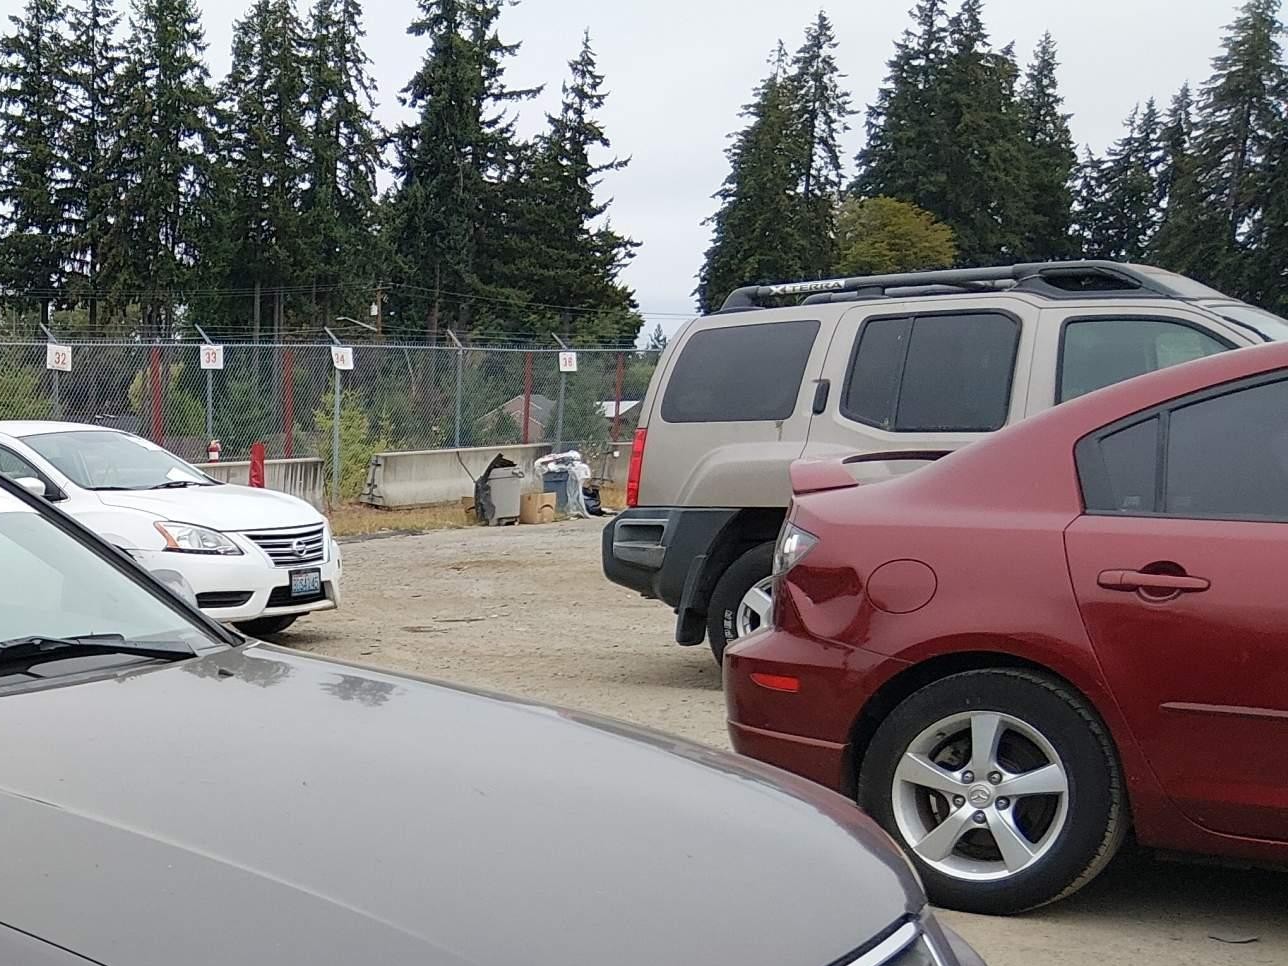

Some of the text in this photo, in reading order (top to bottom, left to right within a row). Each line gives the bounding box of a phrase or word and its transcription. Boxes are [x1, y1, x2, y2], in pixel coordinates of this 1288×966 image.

[769, 281, 842, 295] XTERRA
[55, 351, 67, 366] 32
[205, 351, 217, 364] 33
[334, 352, 345, 365] 34
